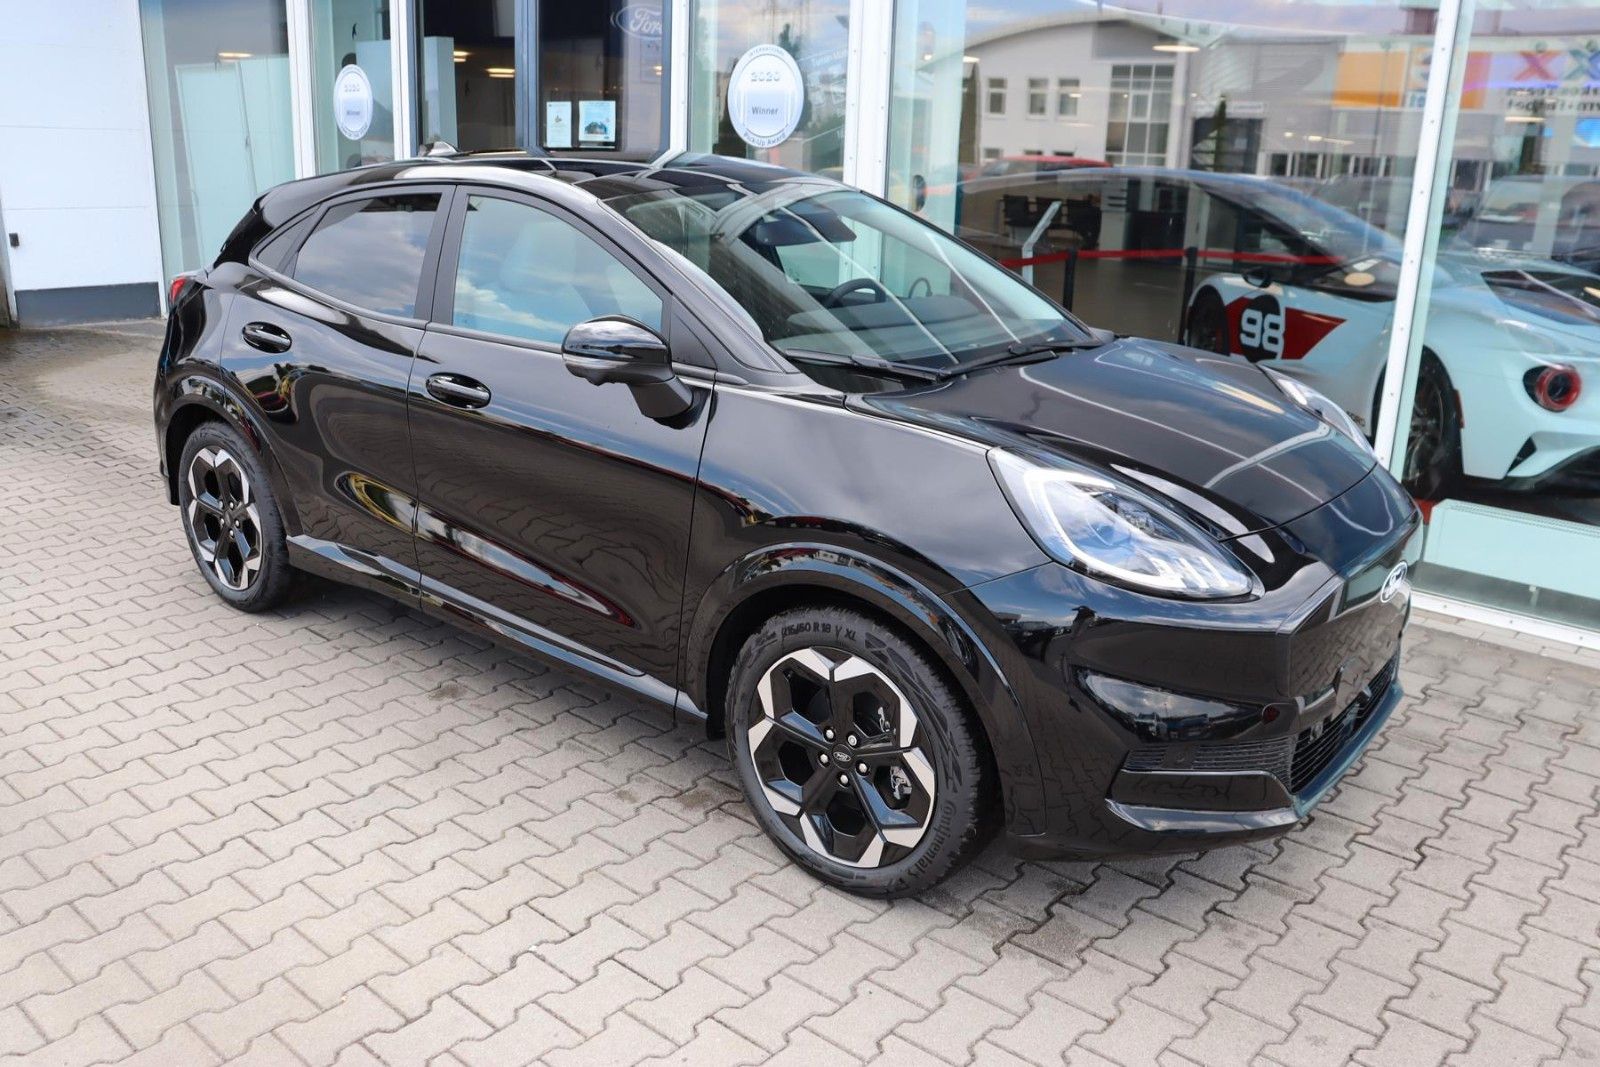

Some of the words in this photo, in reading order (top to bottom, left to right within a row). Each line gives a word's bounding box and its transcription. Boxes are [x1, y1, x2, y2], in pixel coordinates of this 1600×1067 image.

[629, 8, 662, 34] For
[752, 106, 779, 116] Winner
[1240, 308, 1284, 353] 98
